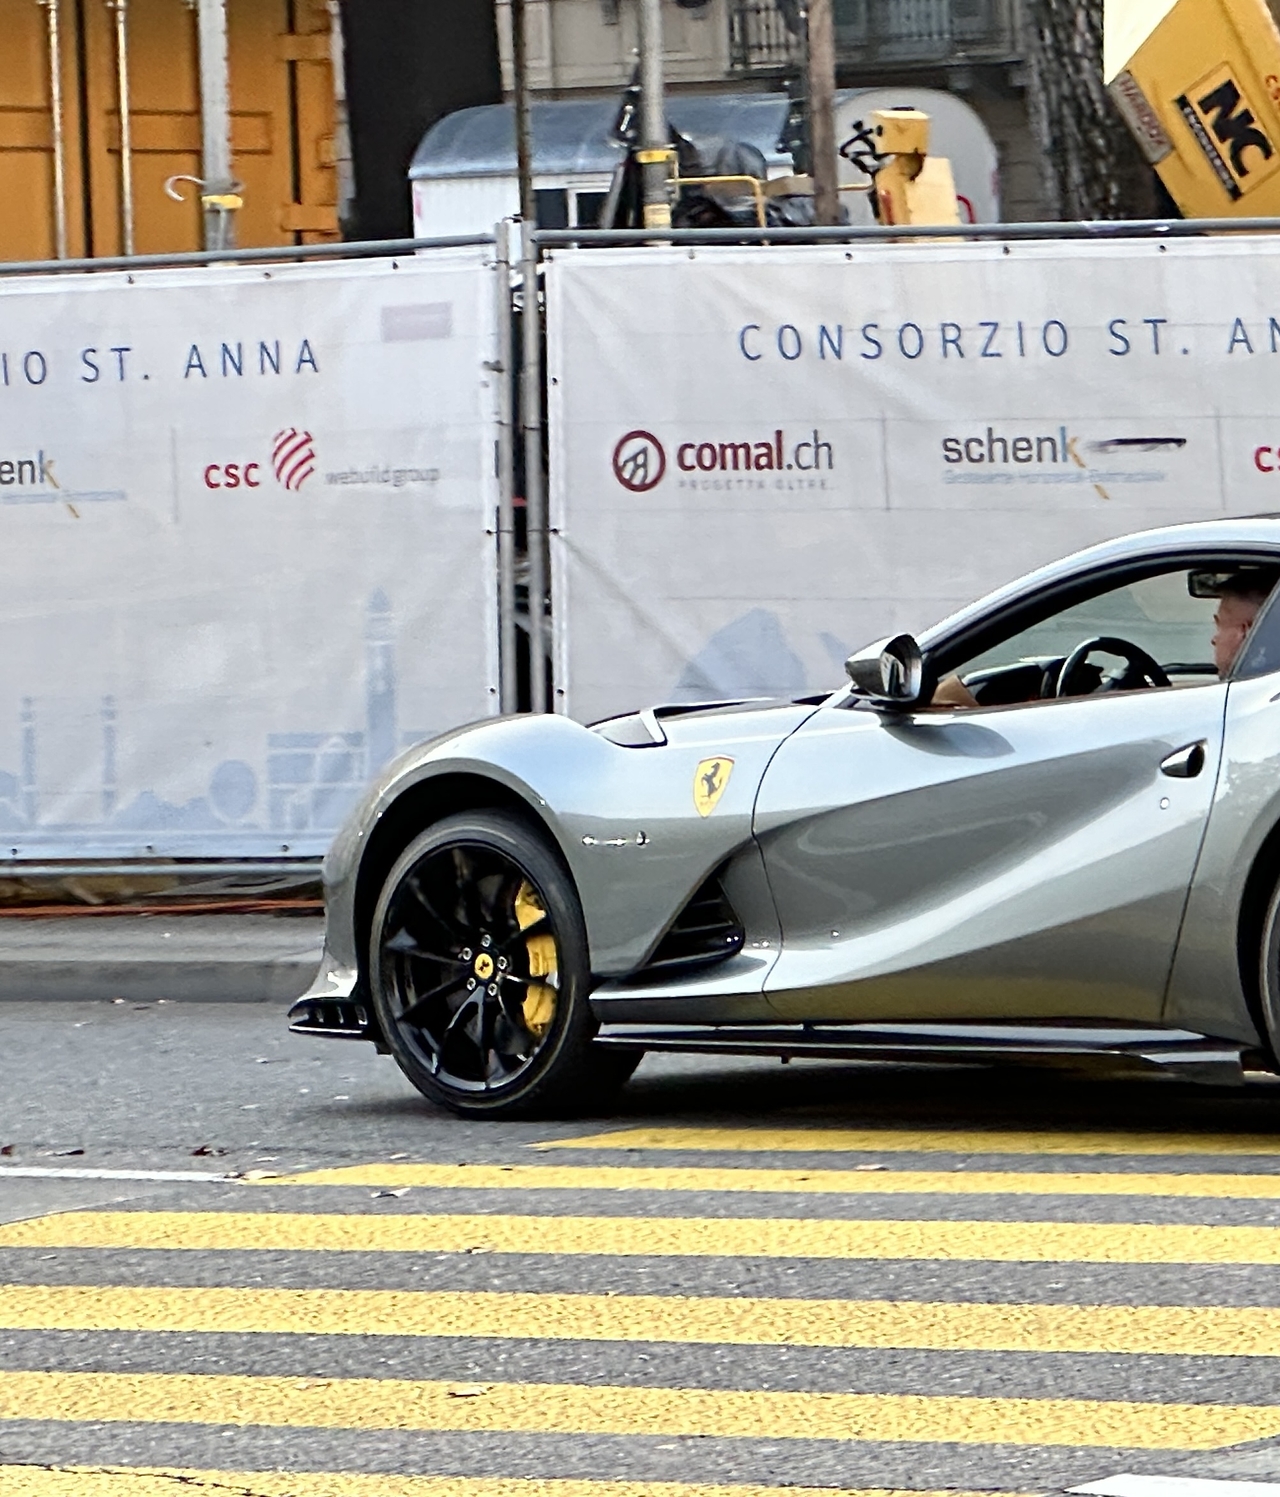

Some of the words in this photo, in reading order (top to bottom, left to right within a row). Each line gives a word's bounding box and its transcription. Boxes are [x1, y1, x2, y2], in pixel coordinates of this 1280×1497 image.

[1198, 78, 1273, 178] NC
[739, 319, 1070, 361] CONSORZIO
[1108, 318, 1190, 357] ST.
[80, 347, 150, 384] ST.
[183, 339, 320, 379] ANNA
[676, 429, 834, 472] comal.ch
[941, 426, 1087, 470] schenk
[204, 462, 261, 489] csc
